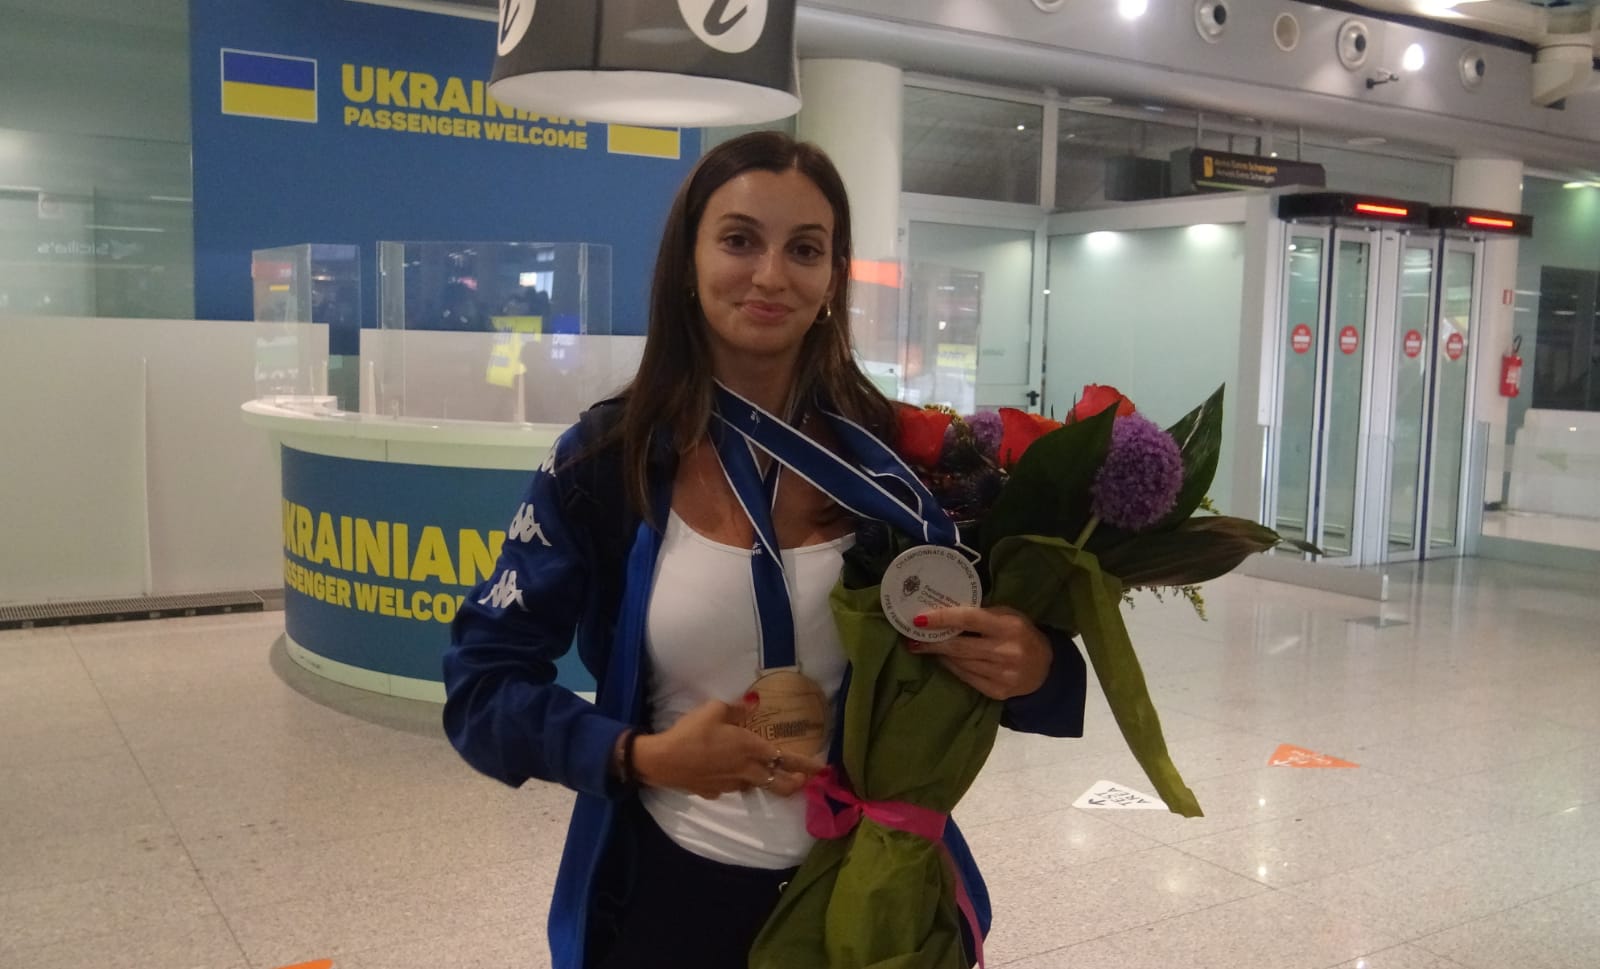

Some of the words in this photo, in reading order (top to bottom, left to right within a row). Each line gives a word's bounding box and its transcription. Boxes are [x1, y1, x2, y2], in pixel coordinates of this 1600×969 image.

[342, 63, 588, 127] UKRAI
[344, 105, 481, 139] PASSENGER
[484, 121, 588, 150] WELCOME
[284, 500, 506, 587] KRAINIAN
[286, 558, 352, 608] SSENGER
[353, 581, 466, 624] WELCO
